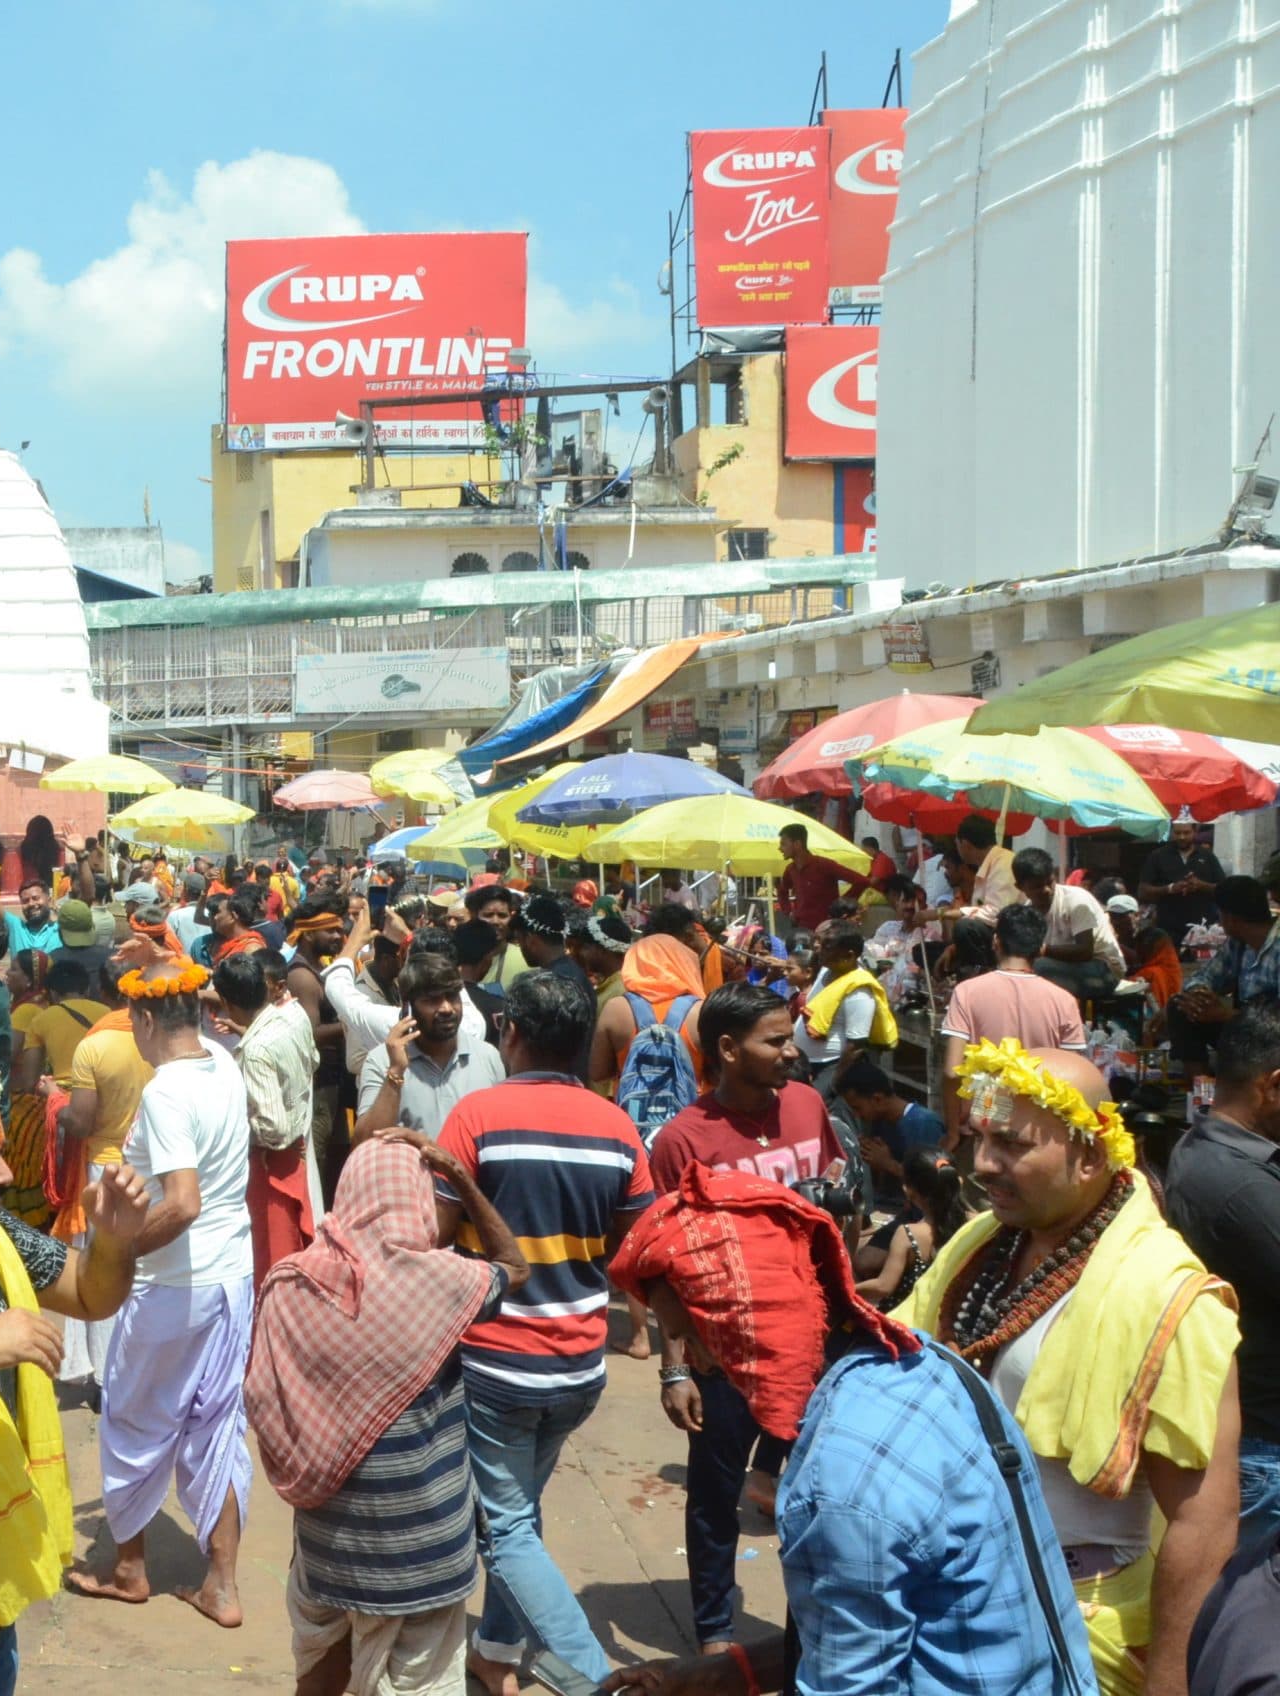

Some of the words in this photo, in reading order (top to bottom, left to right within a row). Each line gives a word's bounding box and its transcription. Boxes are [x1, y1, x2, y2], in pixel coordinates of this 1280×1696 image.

[732, 151, 816, 171] RUPA
[724, 189, 814, 243] Jon
[290, 274, 424, 304] RUPA
[242, 337, 512, 379] FRONTLINE
[385, 380, 423, 391] STYLE
[308, 426, 316, 440] में
[579, 774, 609, 785] LALL
